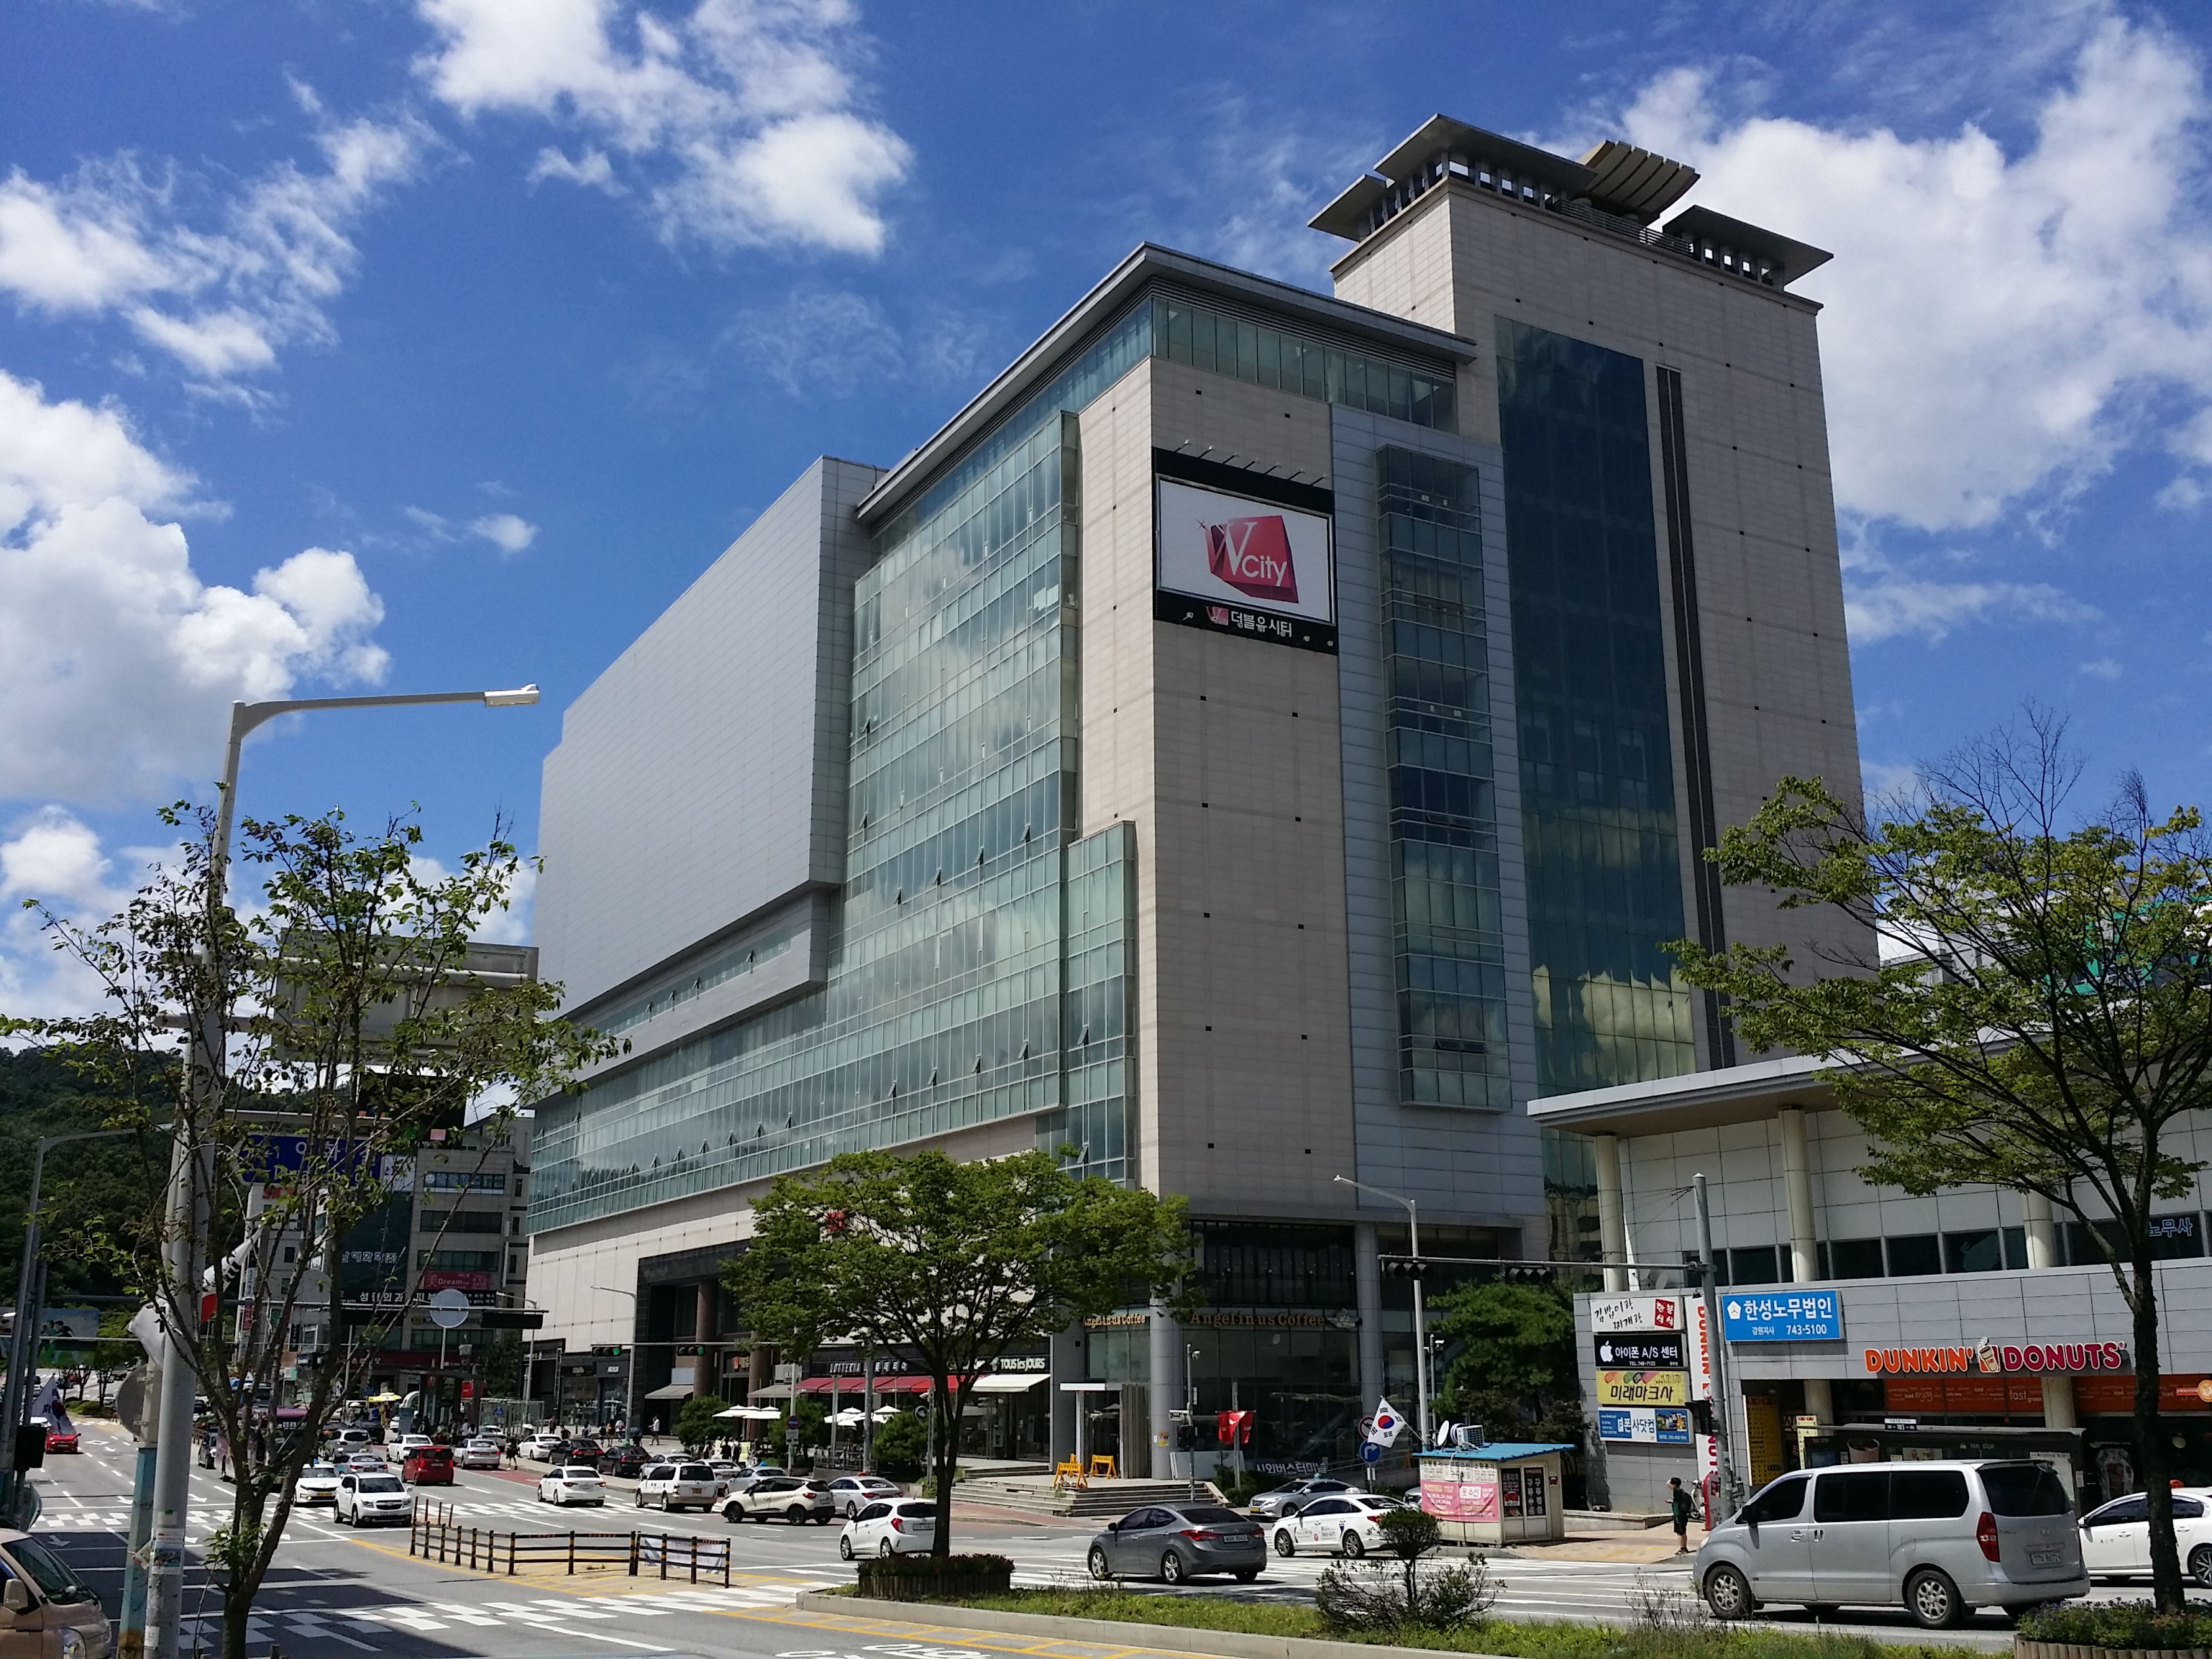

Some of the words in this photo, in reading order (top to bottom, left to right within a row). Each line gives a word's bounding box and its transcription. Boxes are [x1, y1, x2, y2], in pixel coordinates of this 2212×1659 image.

[1230, 610, 1293, 638] 더블유시티
[2148, 1216, 2193, 1238] 노무사
[359, 1292, 404, 1303] 성형외과
[1594, 1298, 1634, 1323] 김밥이랑
[1743, 1296, 1833, 1321] 한성노무법인
[1122, 1313, 1146, 1326] Coffee
[1277, 1312, 1325, 1326] Coffee
[1612, 1312, 1643, 1330] 찌개랑
[1751, 1326, 1775, 1336] 강원지사
[1786, 1324, 1828, 1336] 743-5100
[1615, 1346, 1640, 1359] 아이폰
[1642, 1346, 1659, 1359] A/S
[1660, 1346, 1678, 1359] 센터
[1864, 1346, 1973, 1374] DUNKIN'
[2001, 1342, 2123, 1372] DONUTS
[1000, 1358, 1017, 1370] TOUS
[1025, 1357, 1046, 1371] JOURS
[1610, 1385, 1674, 1402] 미래마크사
[2009, 1389, 2026, 1400] fast
[1256, 1461, 1328, 1475] 시외버스터미널
